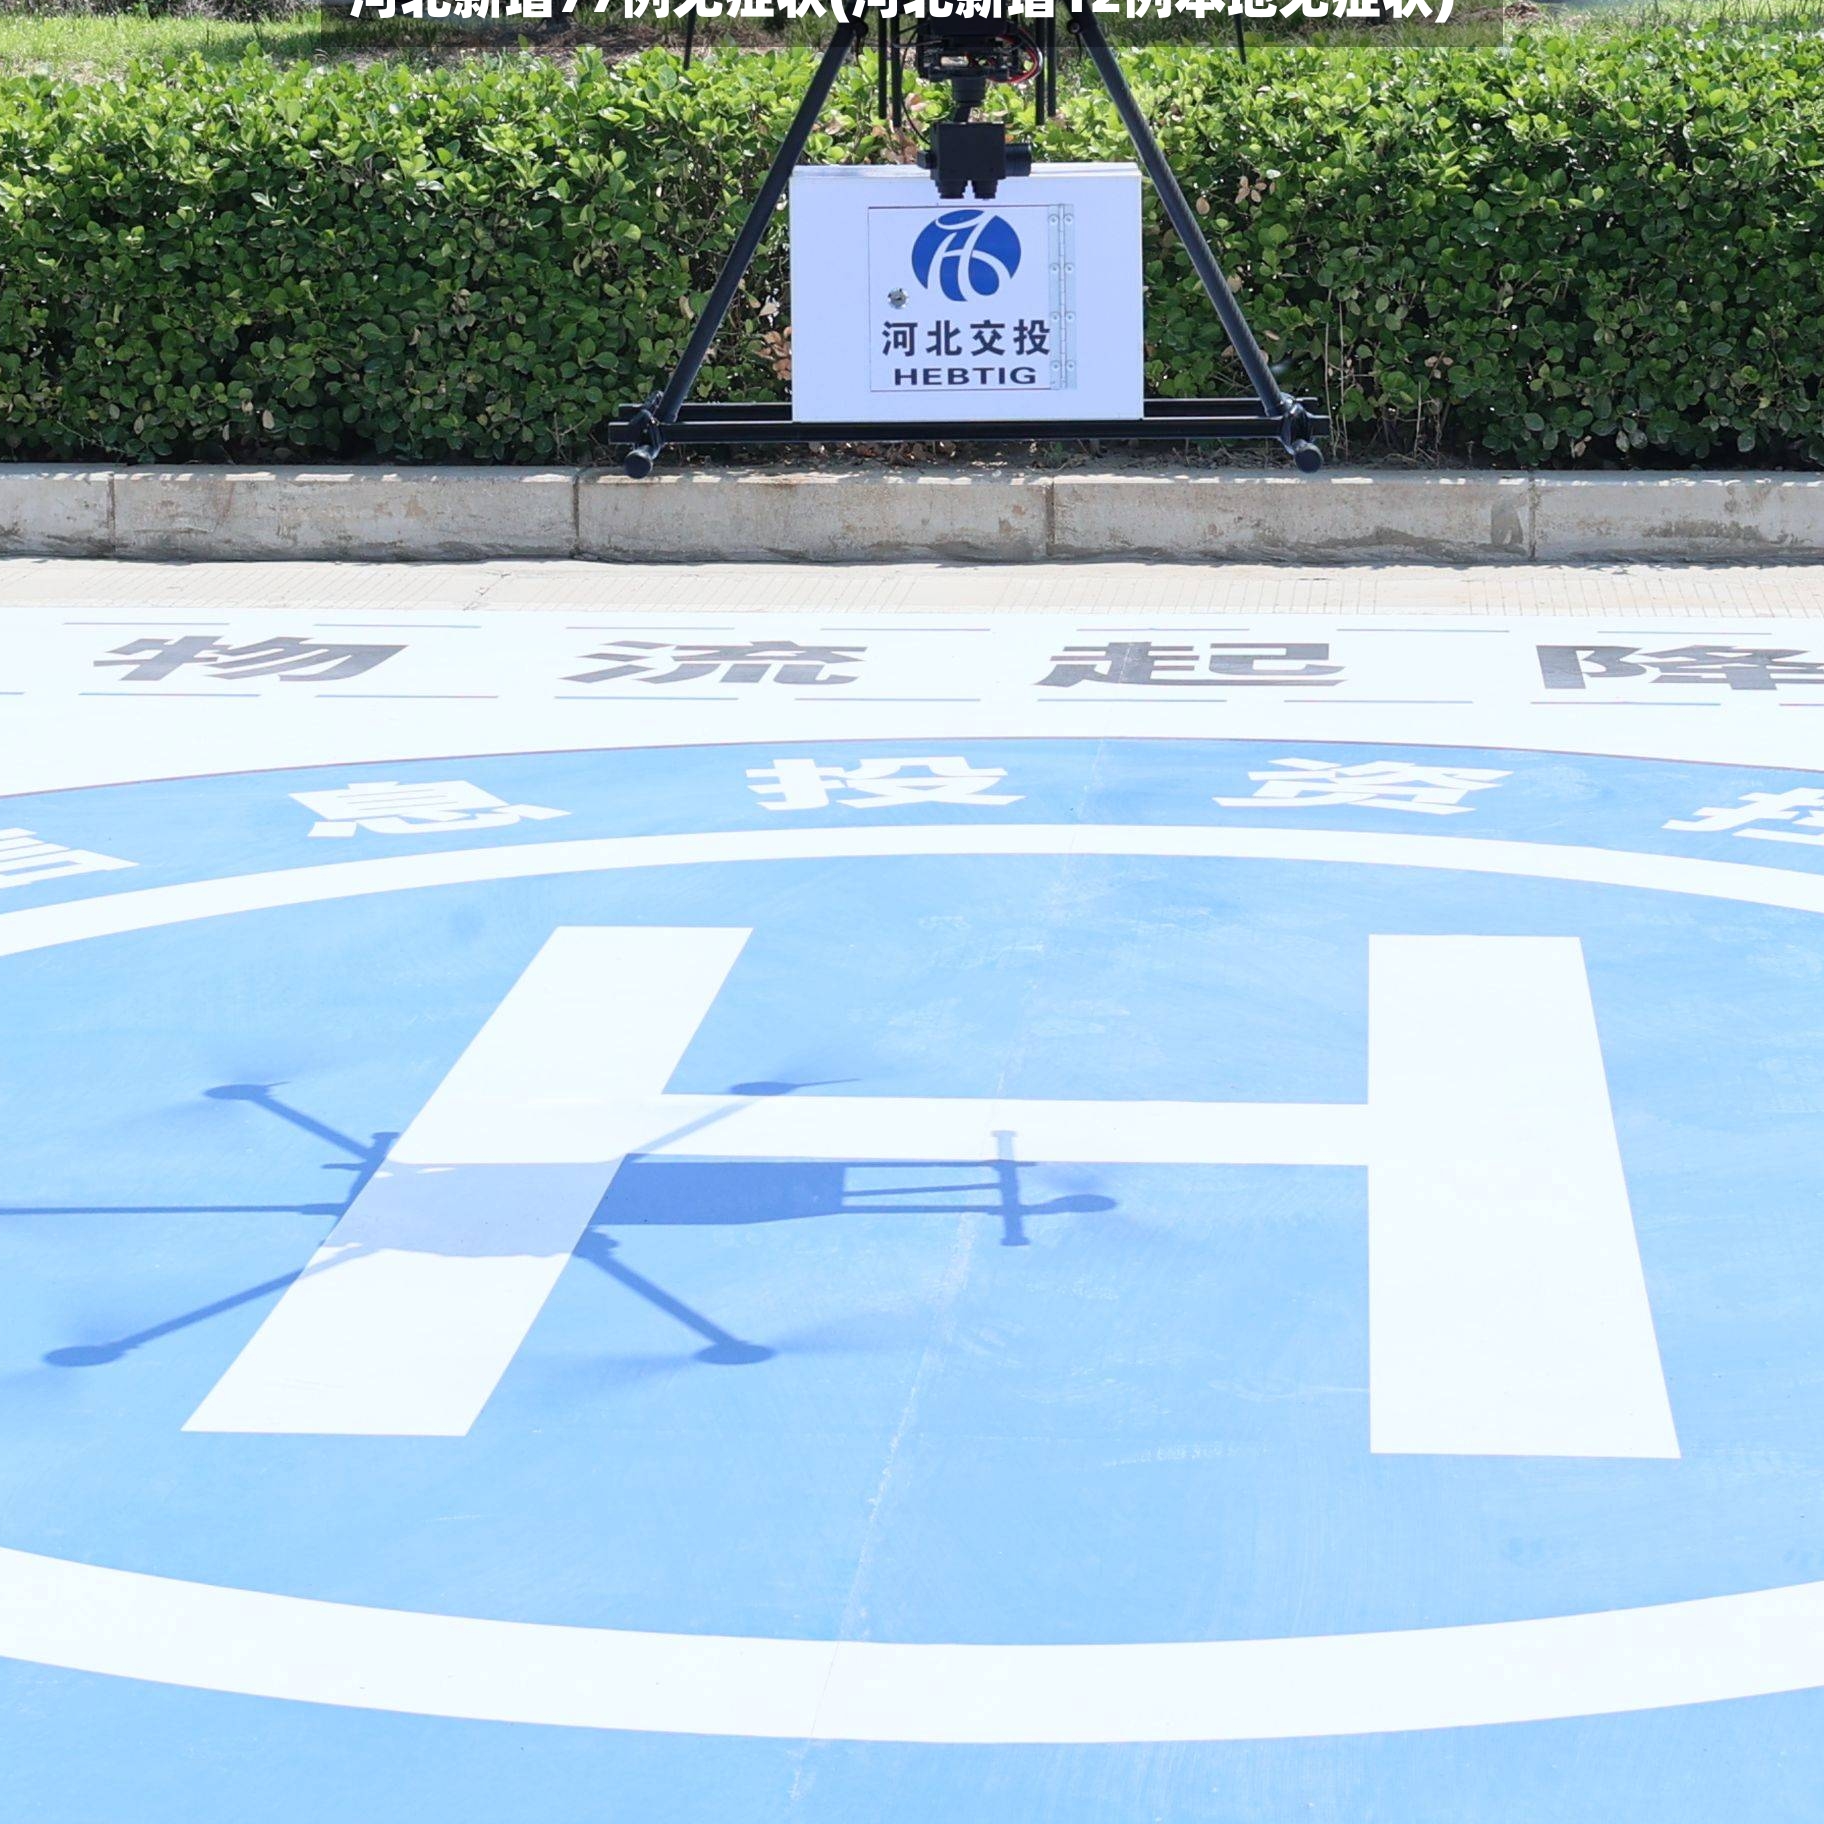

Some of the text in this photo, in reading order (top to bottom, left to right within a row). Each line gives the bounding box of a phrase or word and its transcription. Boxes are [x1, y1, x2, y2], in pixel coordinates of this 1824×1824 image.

[881, 319, 1051, 358] 河北交投
[894, 366, 1037, 386] HEBTIG
[180, 924, 1682, 1459] H
